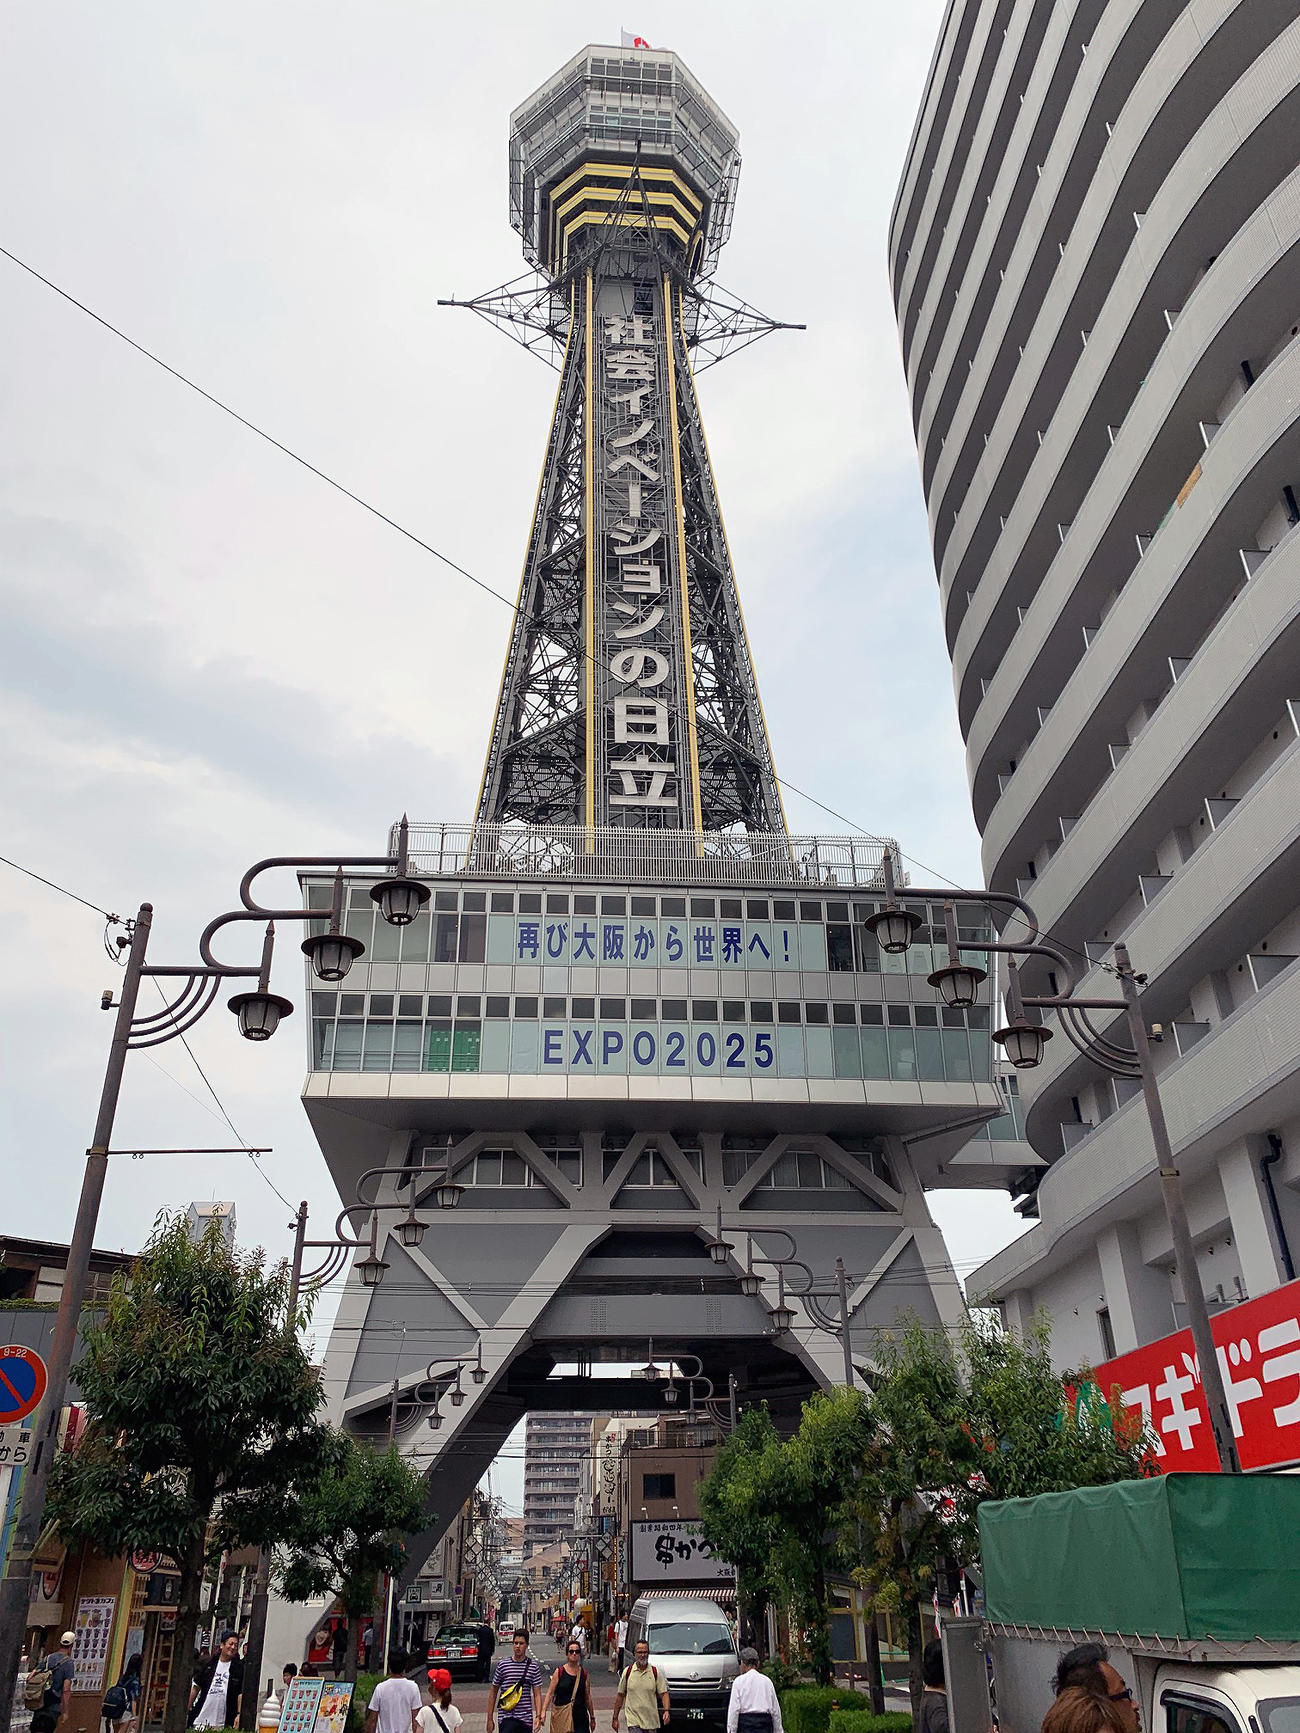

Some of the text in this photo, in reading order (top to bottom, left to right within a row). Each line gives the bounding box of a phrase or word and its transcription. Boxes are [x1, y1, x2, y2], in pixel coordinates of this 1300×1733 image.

[604, 314, 678, 807] 社会イノベーションの日立
[518, 922, 790, 963] 再び大阪から世界へ！
[544, 1030, 773, 1068] EXPO2025
[4, 1348, 27, 1358] 9-22
[655, 1533, 717, 1570] 串かつ
